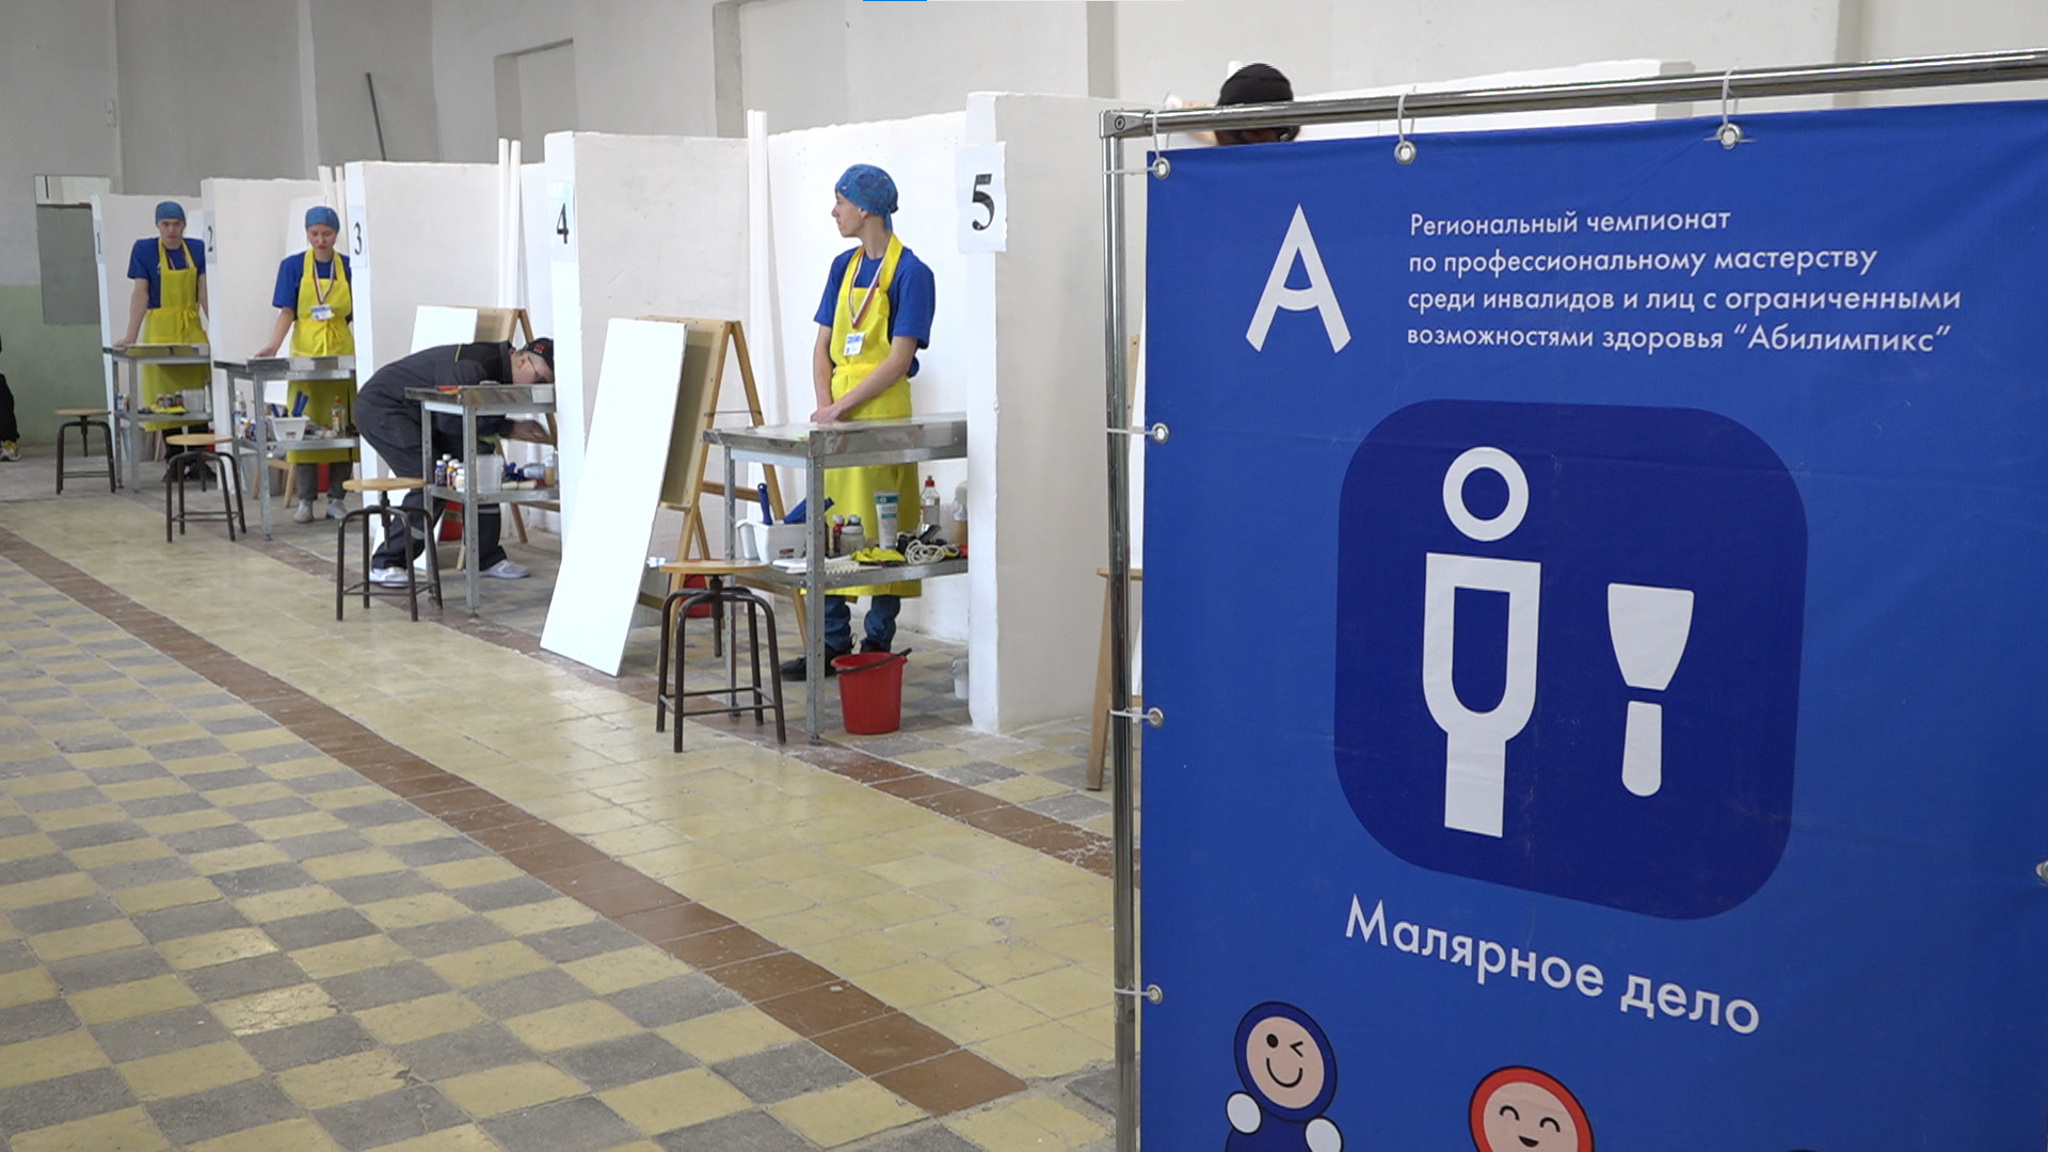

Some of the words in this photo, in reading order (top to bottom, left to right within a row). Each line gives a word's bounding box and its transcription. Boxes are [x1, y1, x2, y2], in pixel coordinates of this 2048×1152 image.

[971, 173, 995, 231] 5
[207, 224, 213, 253] 2
[353, 221, 362, 256] 3
[556, 203, 570, 245] 4
[1410, 210, 1578, 241] Региональный
[1586, 212, 1731, 232] чемпионат
[1409, 256, 1437, 273] по
[1444, 248, 1707, 279] профессиональному
[1713, 250, 1878, 276] мастерству
[1408, 292, 1475, 315] среди
[1483, 292, 1615, 313] инвалидов
[1623, 293, 1638, 309] и
[1645, 292, 1696, 313] лиц
[1703, 292, 1717, 309] с
[1725, 291, 1961, 317] ограниченными
[1407, 329, 1594, 347] возможностями
[1602, 331, 1723, 355] здоровья
[1345, 894, 1604, 997] Малярное
[1620, 974, 1759, 1034] дело
